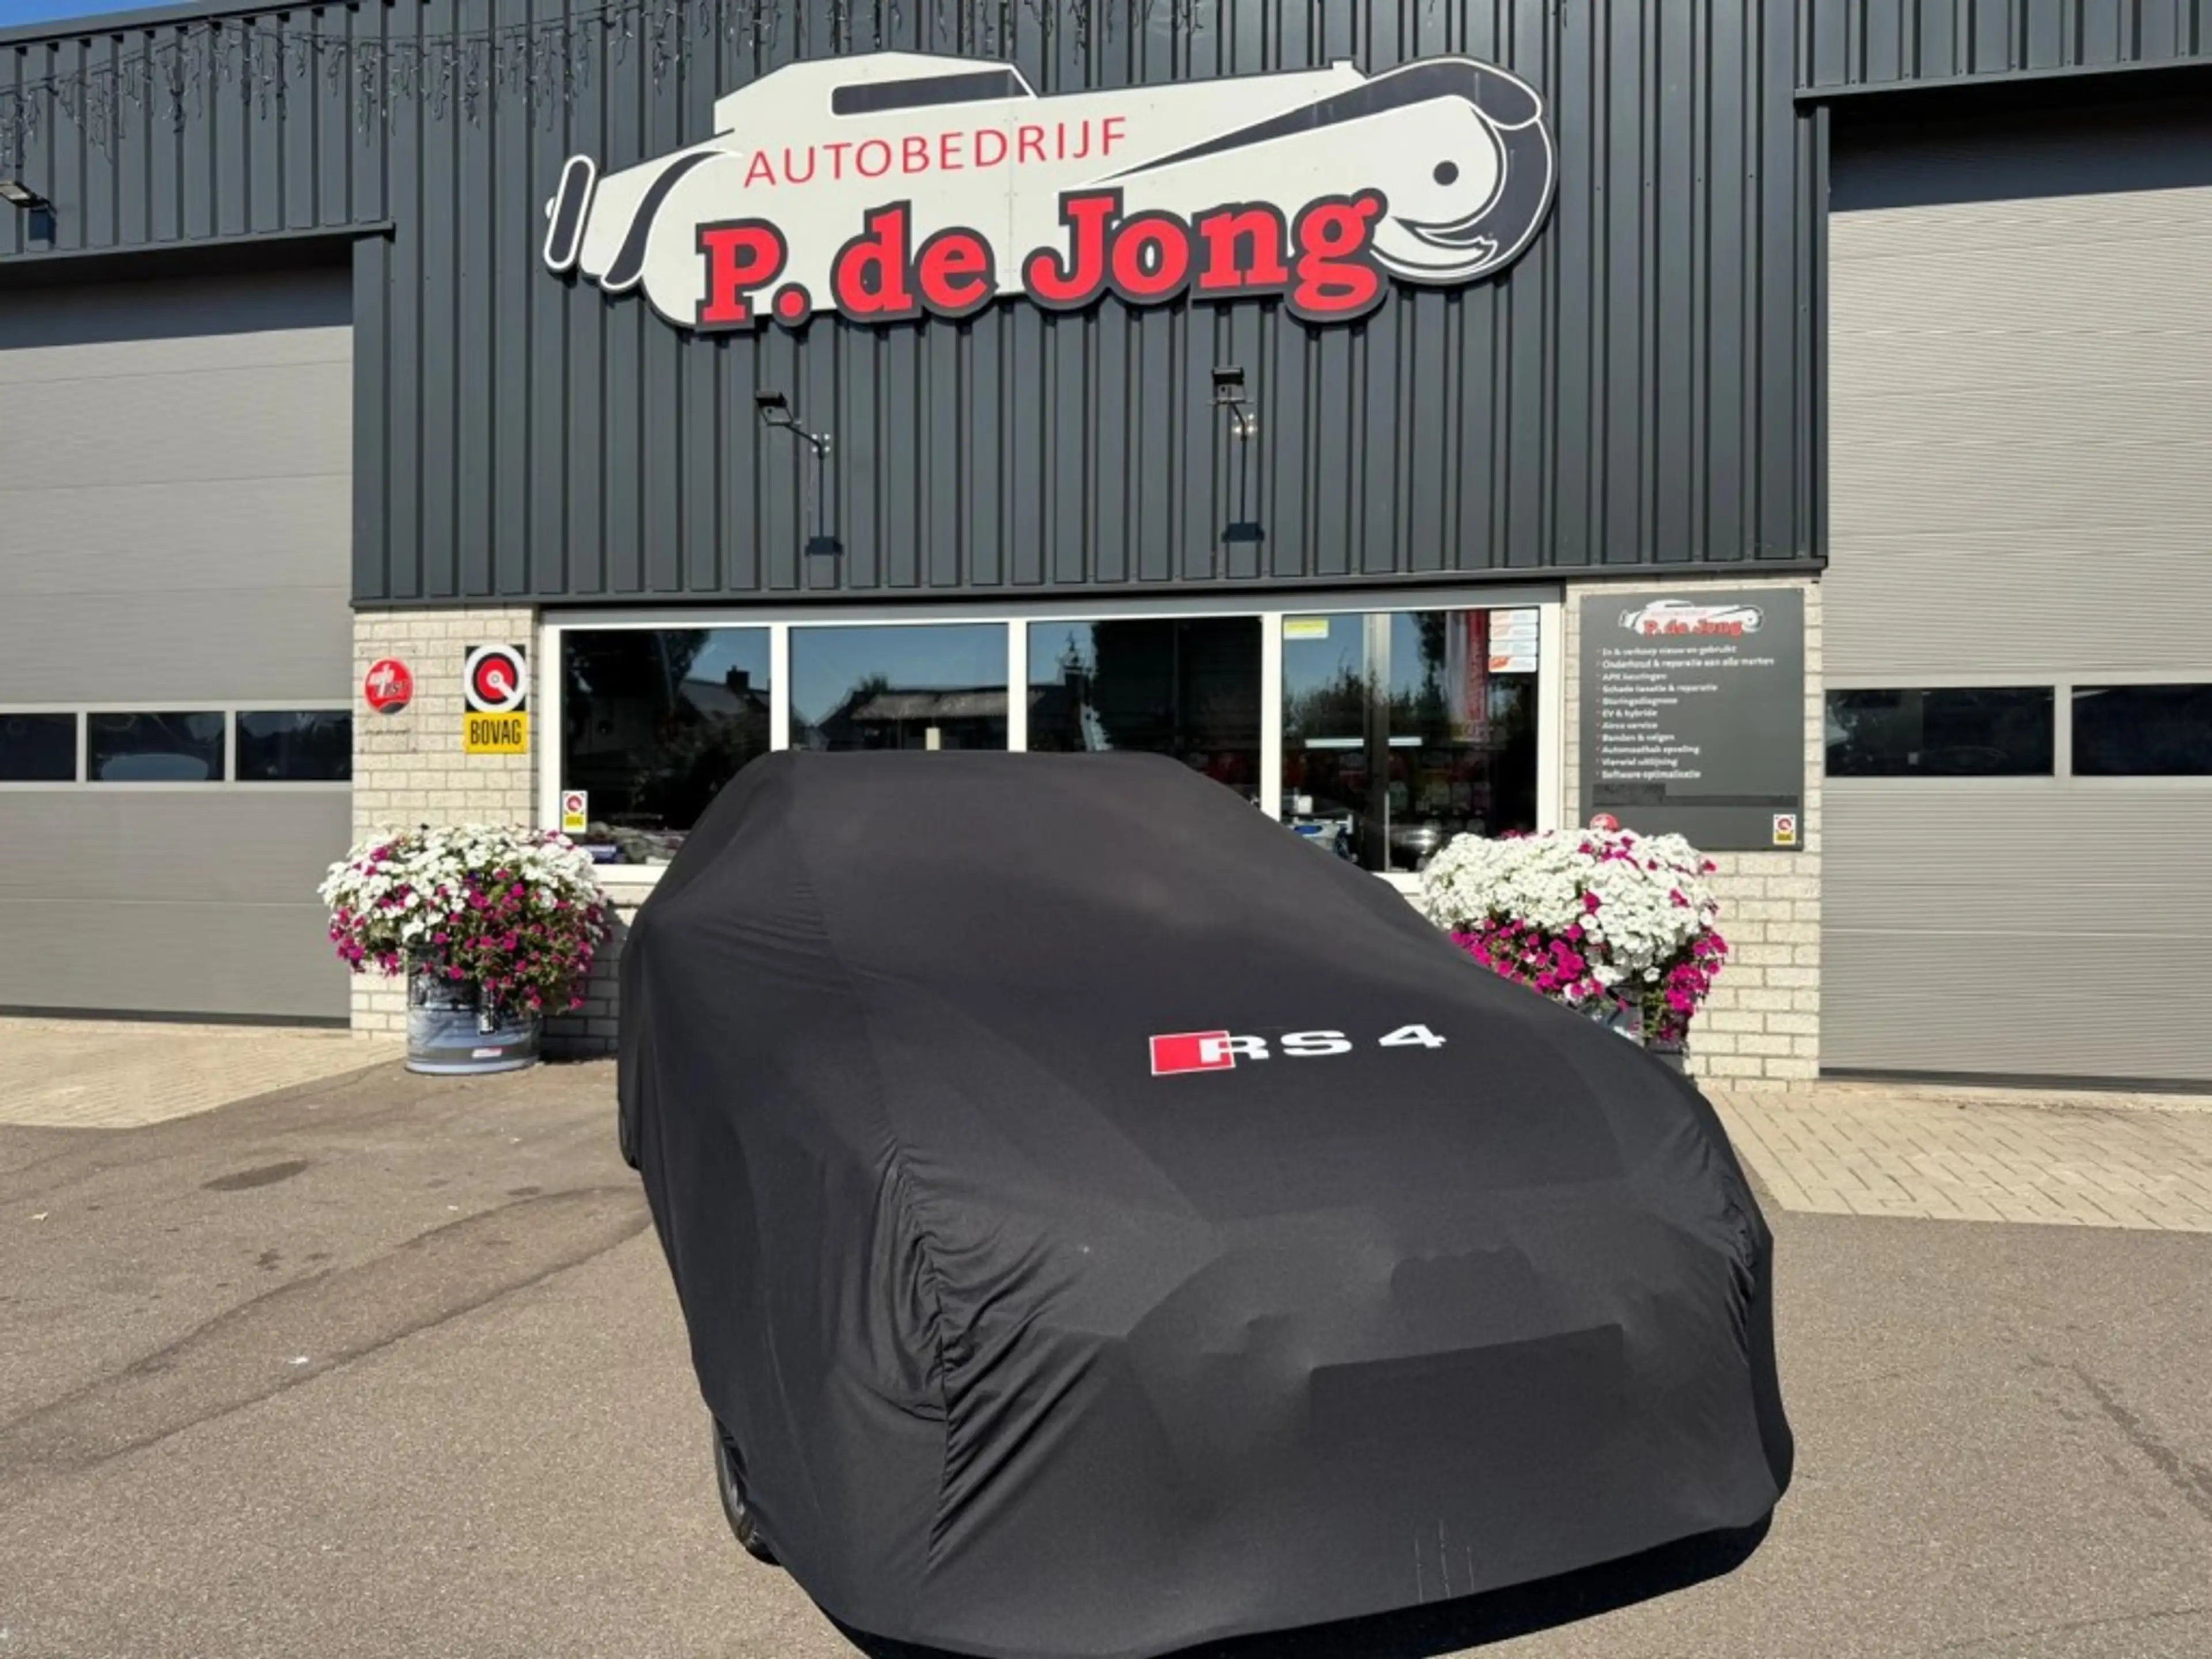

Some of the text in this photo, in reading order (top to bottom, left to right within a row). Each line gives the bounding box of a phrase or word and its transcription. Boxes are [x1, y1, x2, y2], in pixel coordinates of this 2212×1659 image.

[744, 117, 1126, 188] AUTOBEDRIJF
[699, 194, 1381, 325] P. de Jong
[1664, 619, 1689, 635] de
[1692, 619, 1742, 638] Jong
[1699, 645, 1737, 656] gebruikt
[1603, 659, 1652, 668] Onderhoud
[1661, 658, 1702, 669] reparatie
[1603, 673, 1621, 681] APK
[471, 719, 521, 745] BOVAG
[1602, 768, 1641, 779] Software
